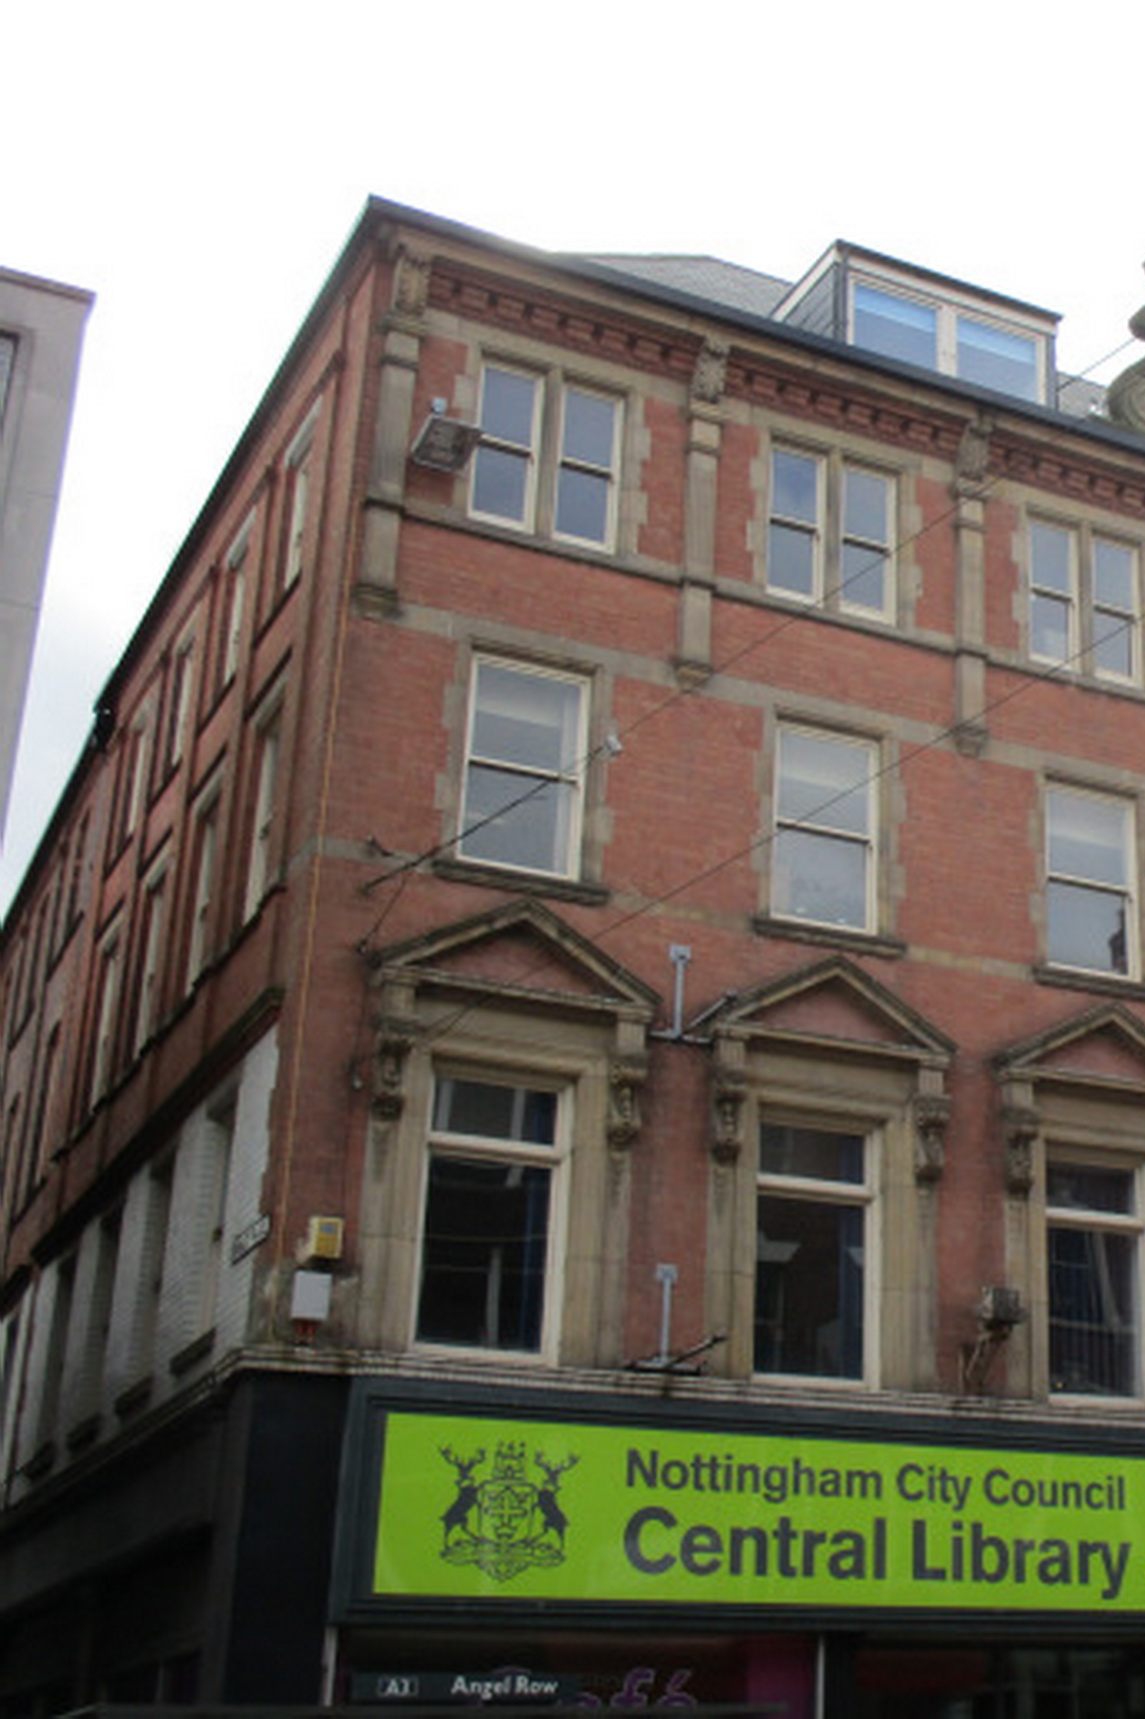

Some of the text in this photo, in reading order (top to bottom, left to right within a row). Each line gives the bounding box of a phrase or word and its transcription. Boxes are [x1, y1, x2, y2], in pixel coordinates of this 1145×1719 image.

[626, 1449, 1125, 1511] Nottingham City Council
[623, 1506, 887, 1580] Central
[911, 1520, 1131, 1600] Library
[450, 1676, 512, 1699] Angel
[514, 1678, 559, 1694] Row
